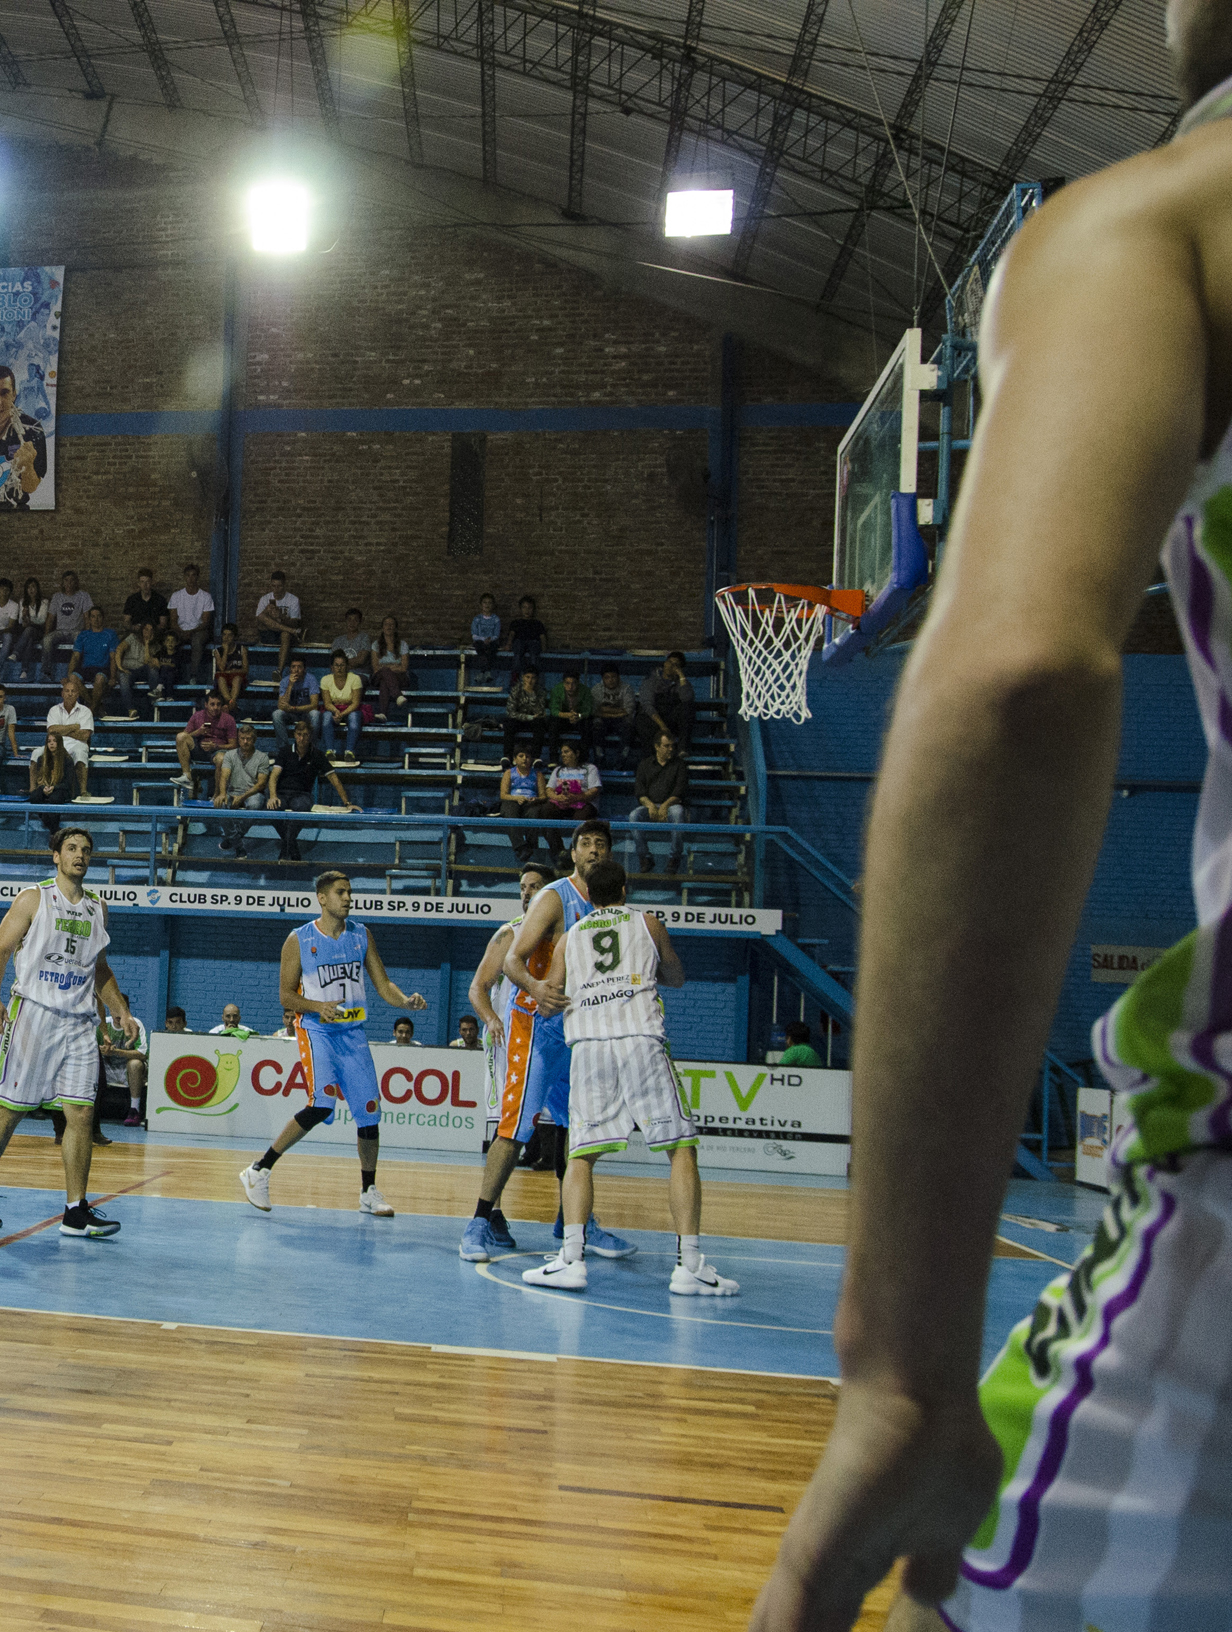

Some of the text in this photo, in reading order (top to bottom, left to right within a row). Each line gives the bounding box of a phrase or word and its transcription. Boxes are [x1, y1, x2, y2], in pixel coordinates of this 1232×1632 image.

[0, 886, 24, 899] CL
[100, 890, 137, 902] JULIO
[169, 892, 312, 908] CLUB SP. 9 DE JULIO
[348, 899, 492, 915] CLUB SP. 9 DE JULIO
[671, 909, 681, 922] 9
[683, 910, 704, 923] DE
[708, 912, 757, 925] JULIO
[55, 918, 92, 937] FERRO
[64, 938, 78, 955] 15
[592, 929, 620, 974] 9
[1092, 953, 1138, 971] SALIDA
[317, 961, 361, 989] NUEVE
[339, 983, 346, 1000] 7
[336, 1008, 361, 1020] UNY
[251, 1059, 477, 1108] CACOL
[680, 1069, 803, 1112] TV HD
[333, 1107, 475, 1130] upmercados
[692, 1113, 802, 1129] operativa
